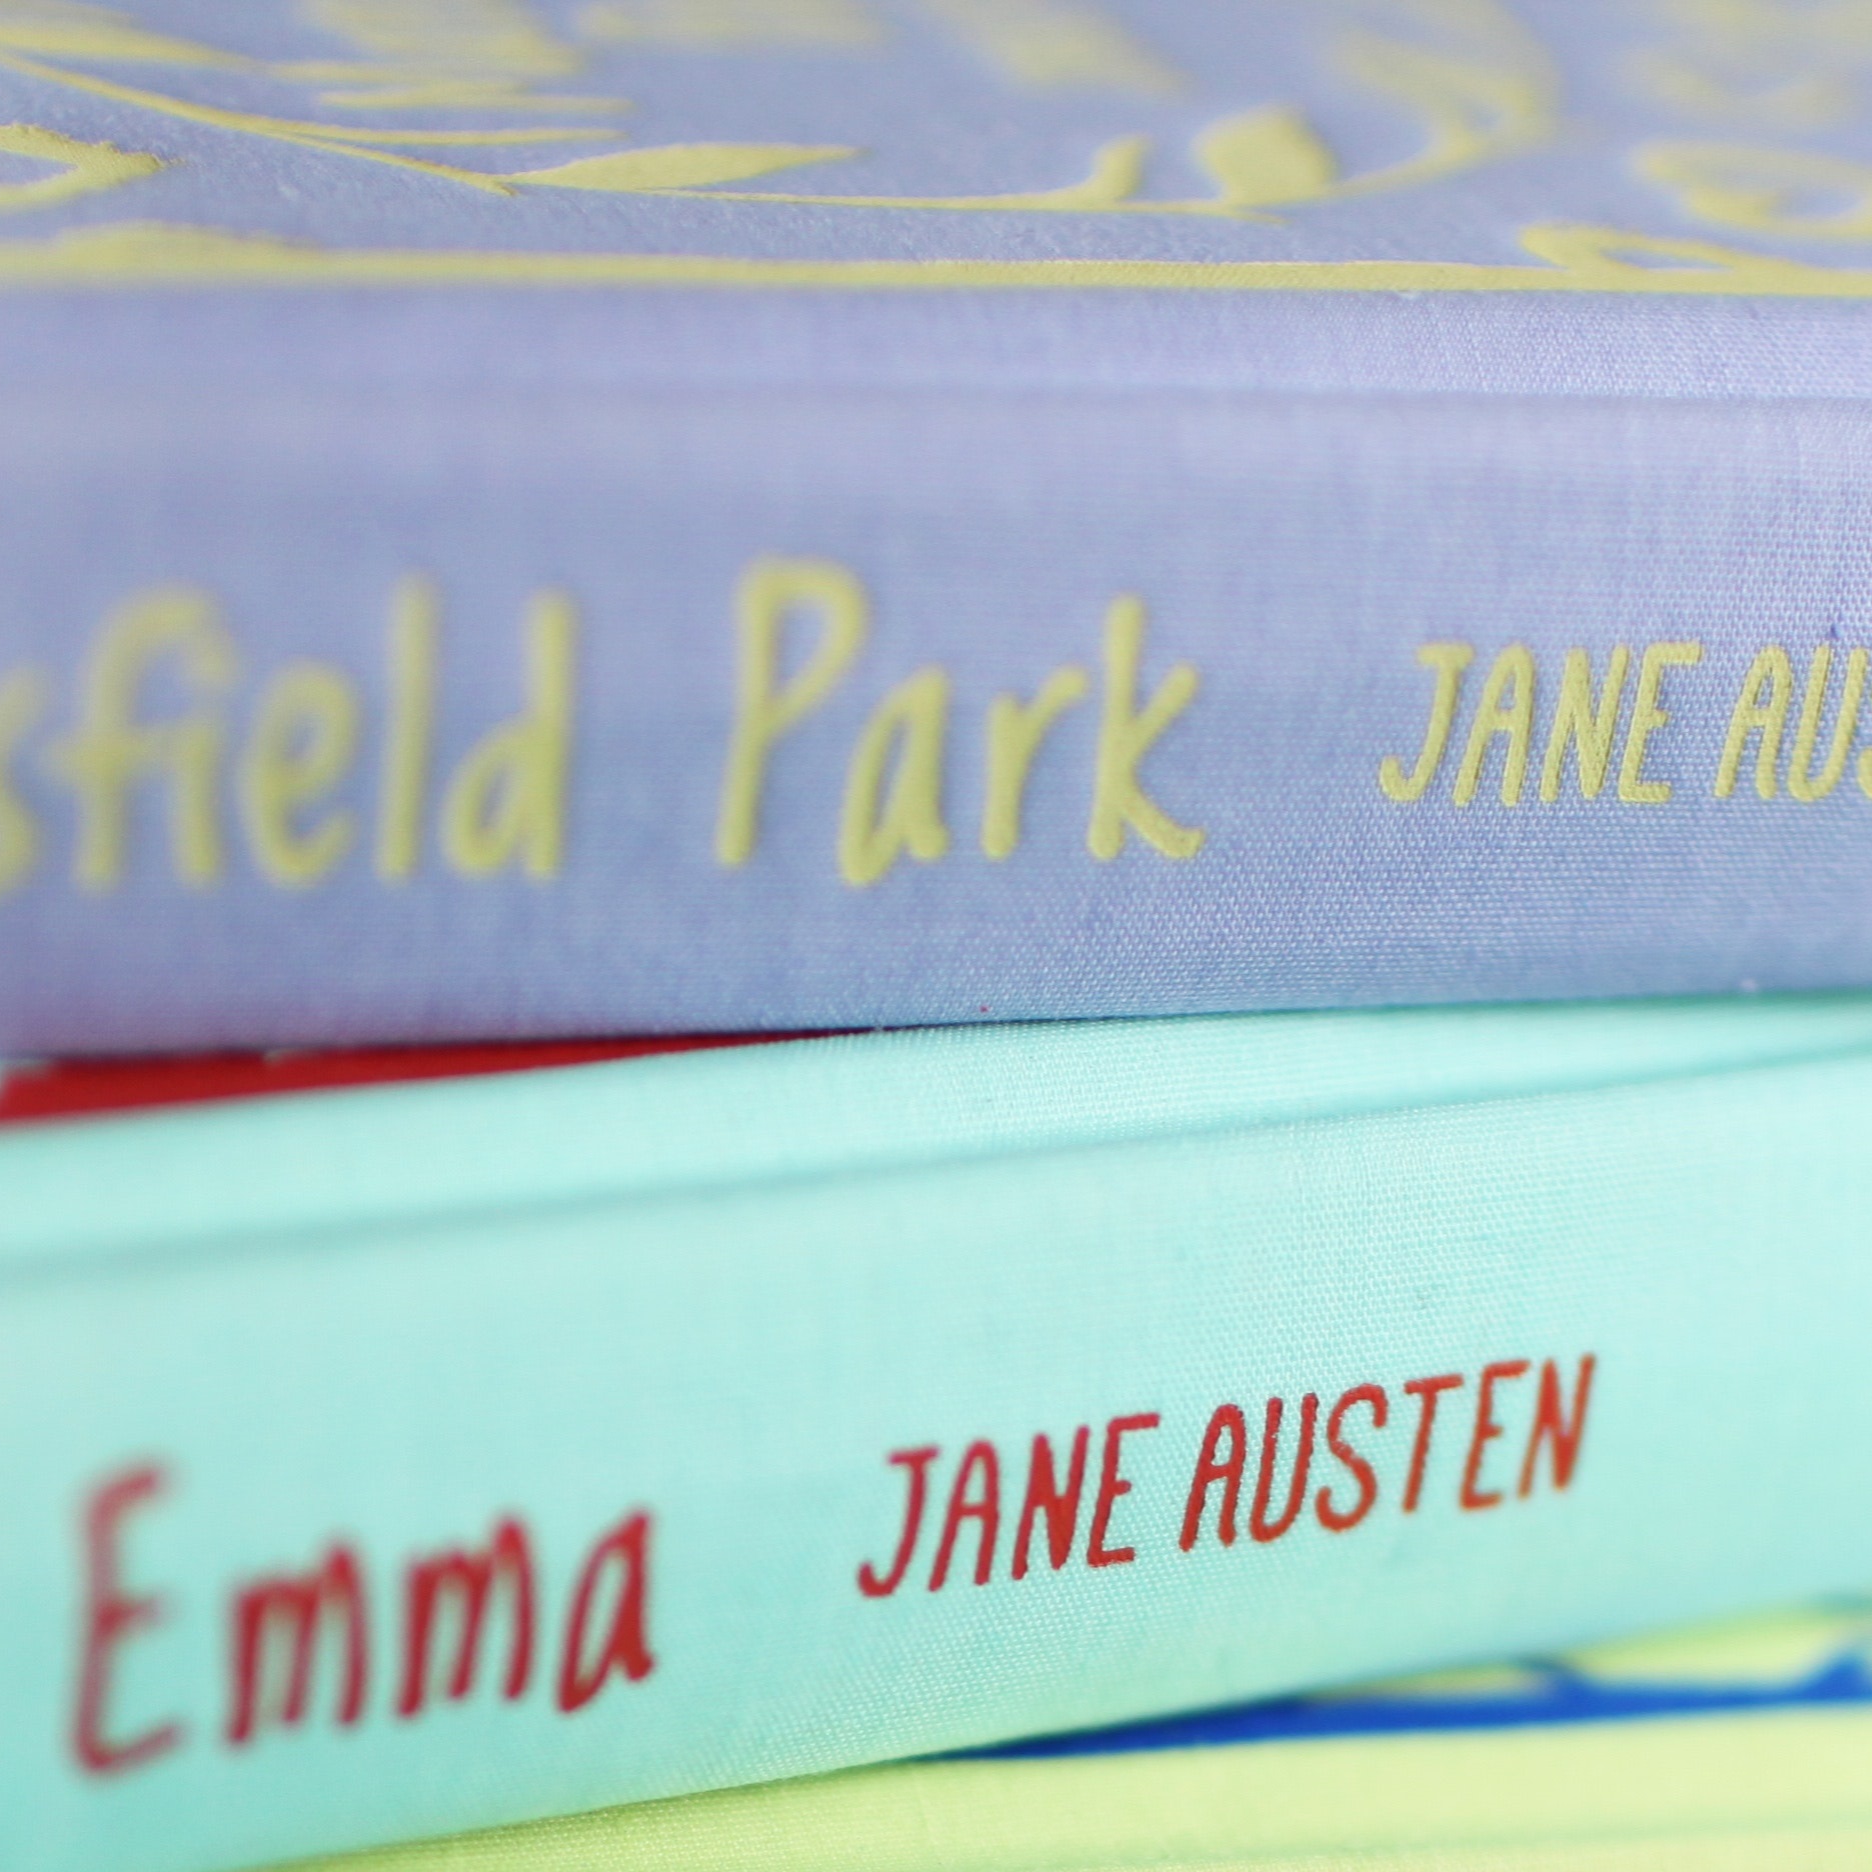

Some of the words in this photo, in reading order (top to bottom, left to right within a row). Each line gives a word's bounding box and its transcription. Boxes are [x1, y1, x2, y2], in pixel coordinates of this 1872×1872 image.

[712, 555, 1205, 885] Park
[1377, 641, 1703, 808] JANE
[66, 1452, 656, 1778] Emma
[855, 1411, 1161, 1600] JANE
[1176, 1353, 1598, 1552] AUSTEN
